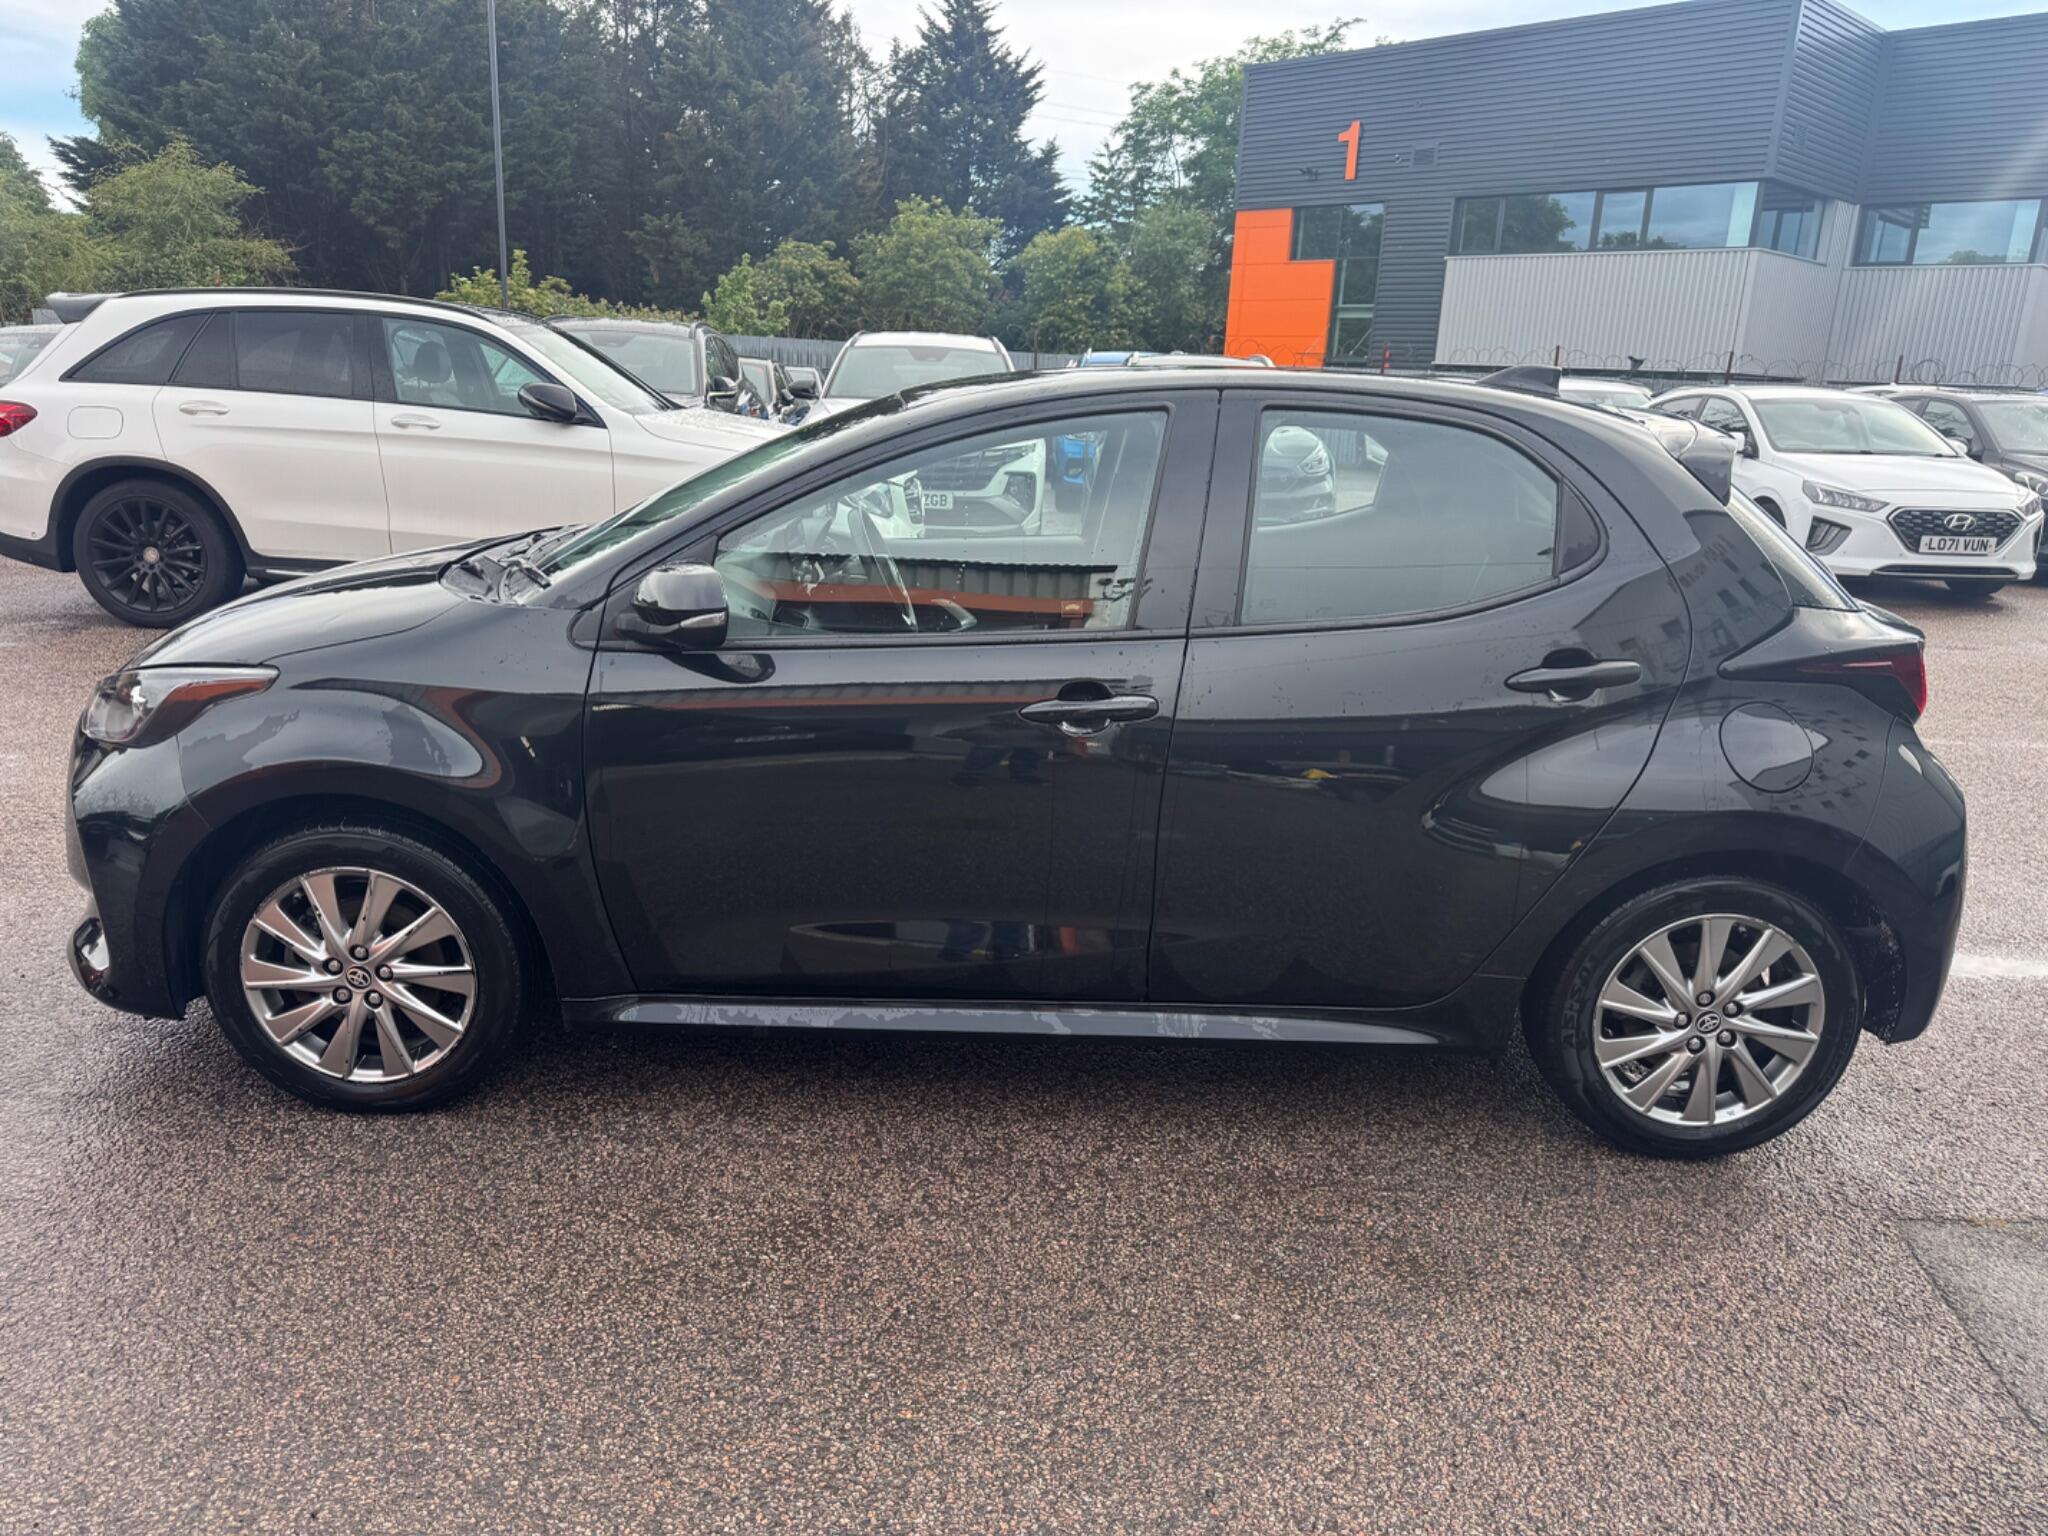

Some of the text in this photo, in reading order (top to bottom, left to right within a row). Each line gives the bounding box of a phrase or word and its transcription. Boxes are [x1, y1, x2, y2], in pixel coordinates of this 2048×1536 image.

[1338, 119, 1360, 181] 1
[924, 494, 947, 506] ZGB
[1928, 537, 1989, 552] LO71 VUN
